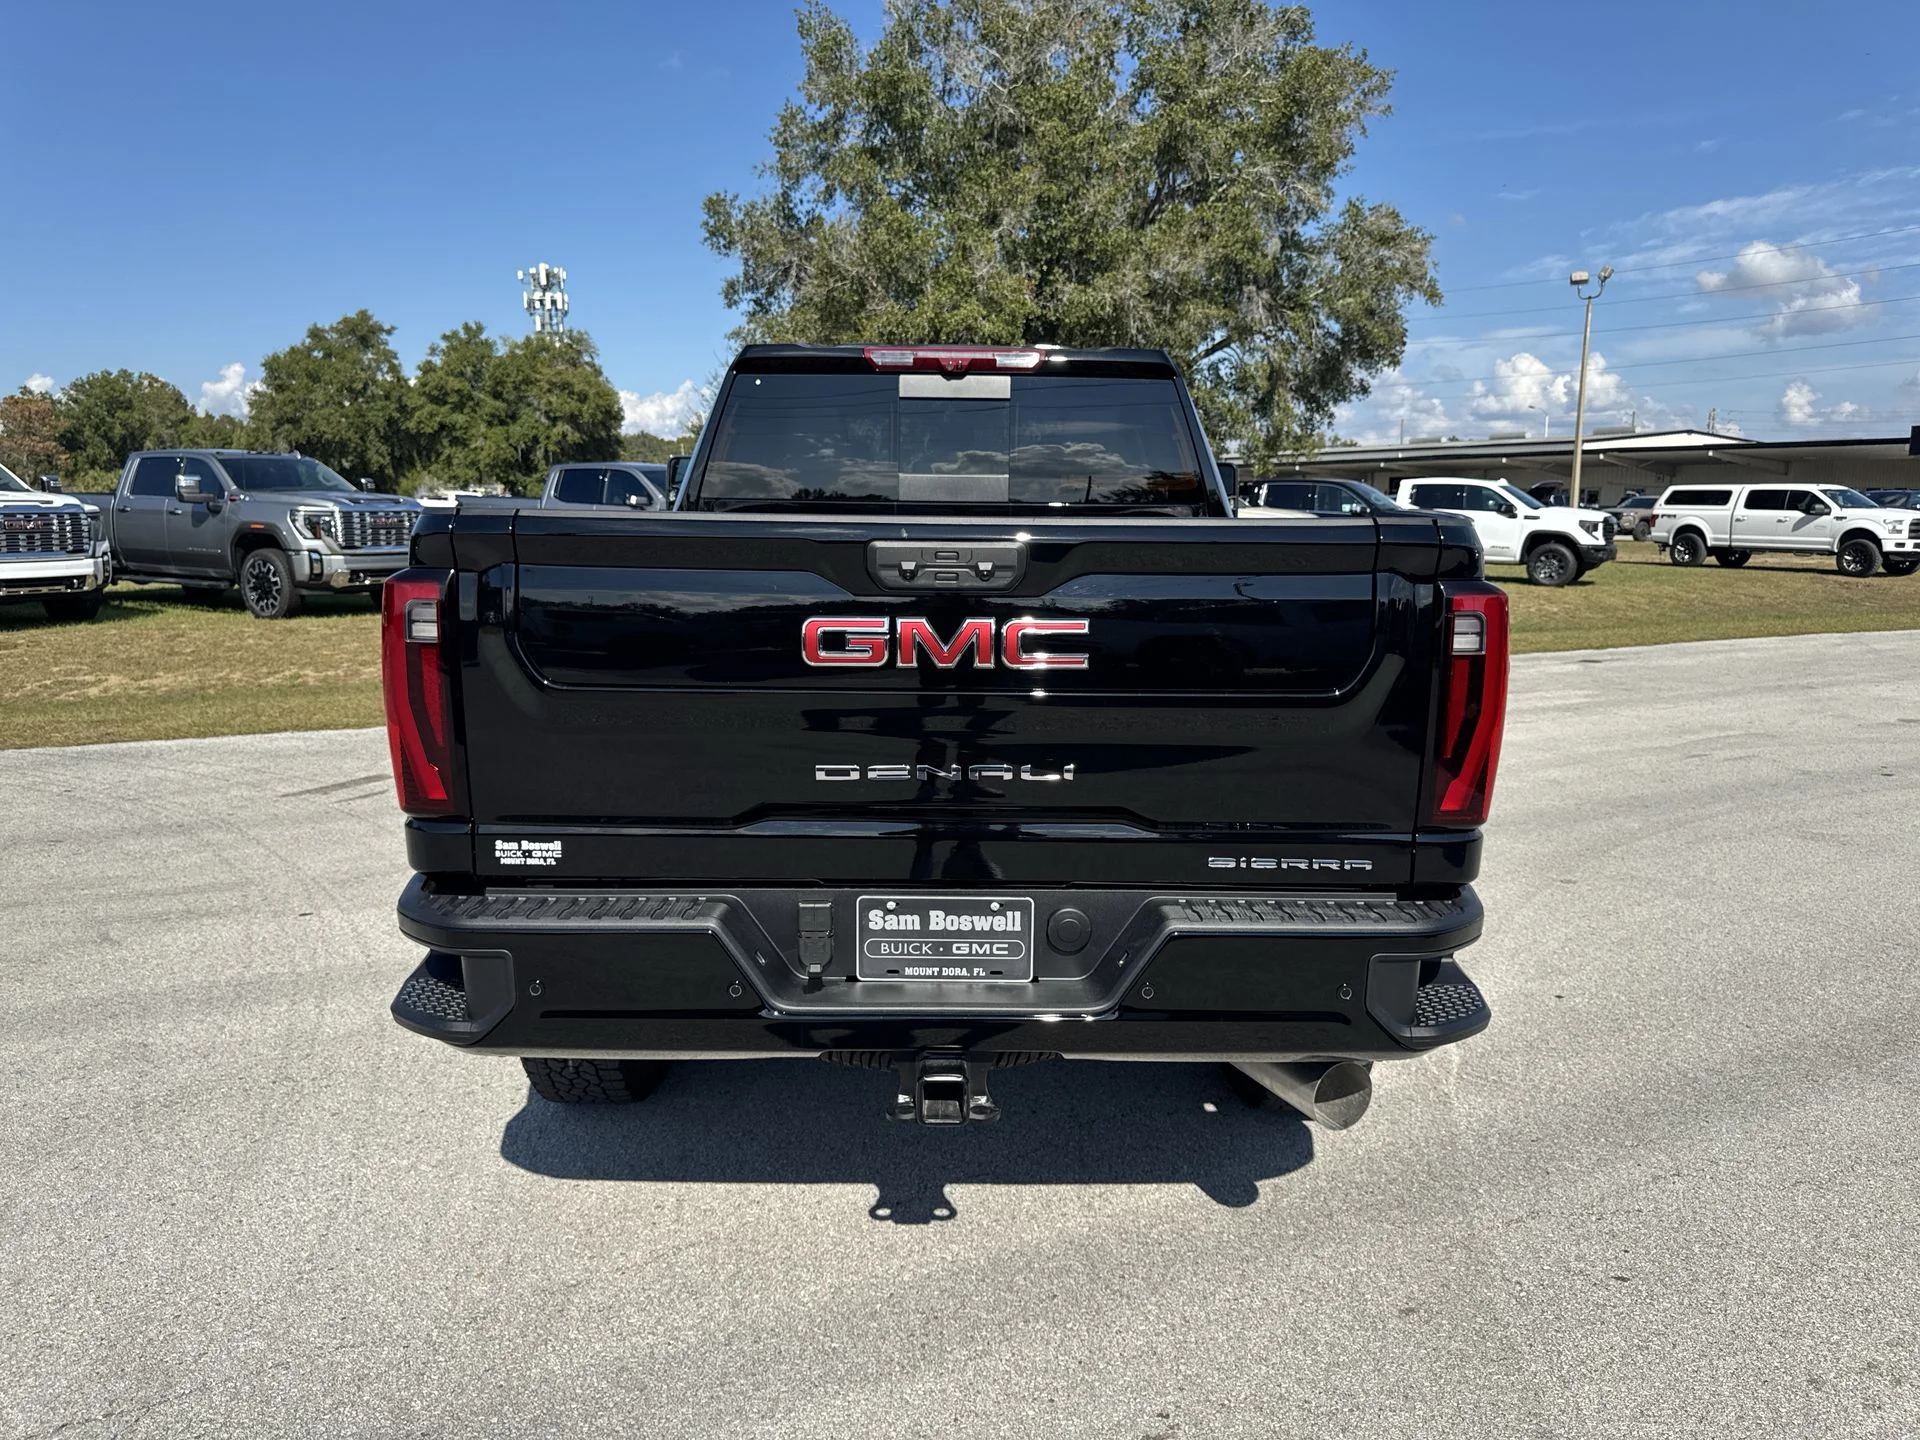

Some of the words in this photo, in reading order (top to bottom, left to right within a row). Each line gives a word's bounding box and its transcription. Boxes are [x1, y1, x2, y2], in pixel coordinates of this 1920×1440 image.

[801, 616, 1090, 669] GMC
[815, 764, 1075, 781] DENALI
[495, 840, 518, 850] Sam
[521, 840, 561, 850] Boswell
[868, 909, 920, 930] Sam
[929, 910, 1021, 931] Boswell
[881, 942, 933, 954] BUICK
[952, 943, 1009, 955] GMC
[905, 967, 939, 976] MOUNT
[973, 967, 986, 977] FL
